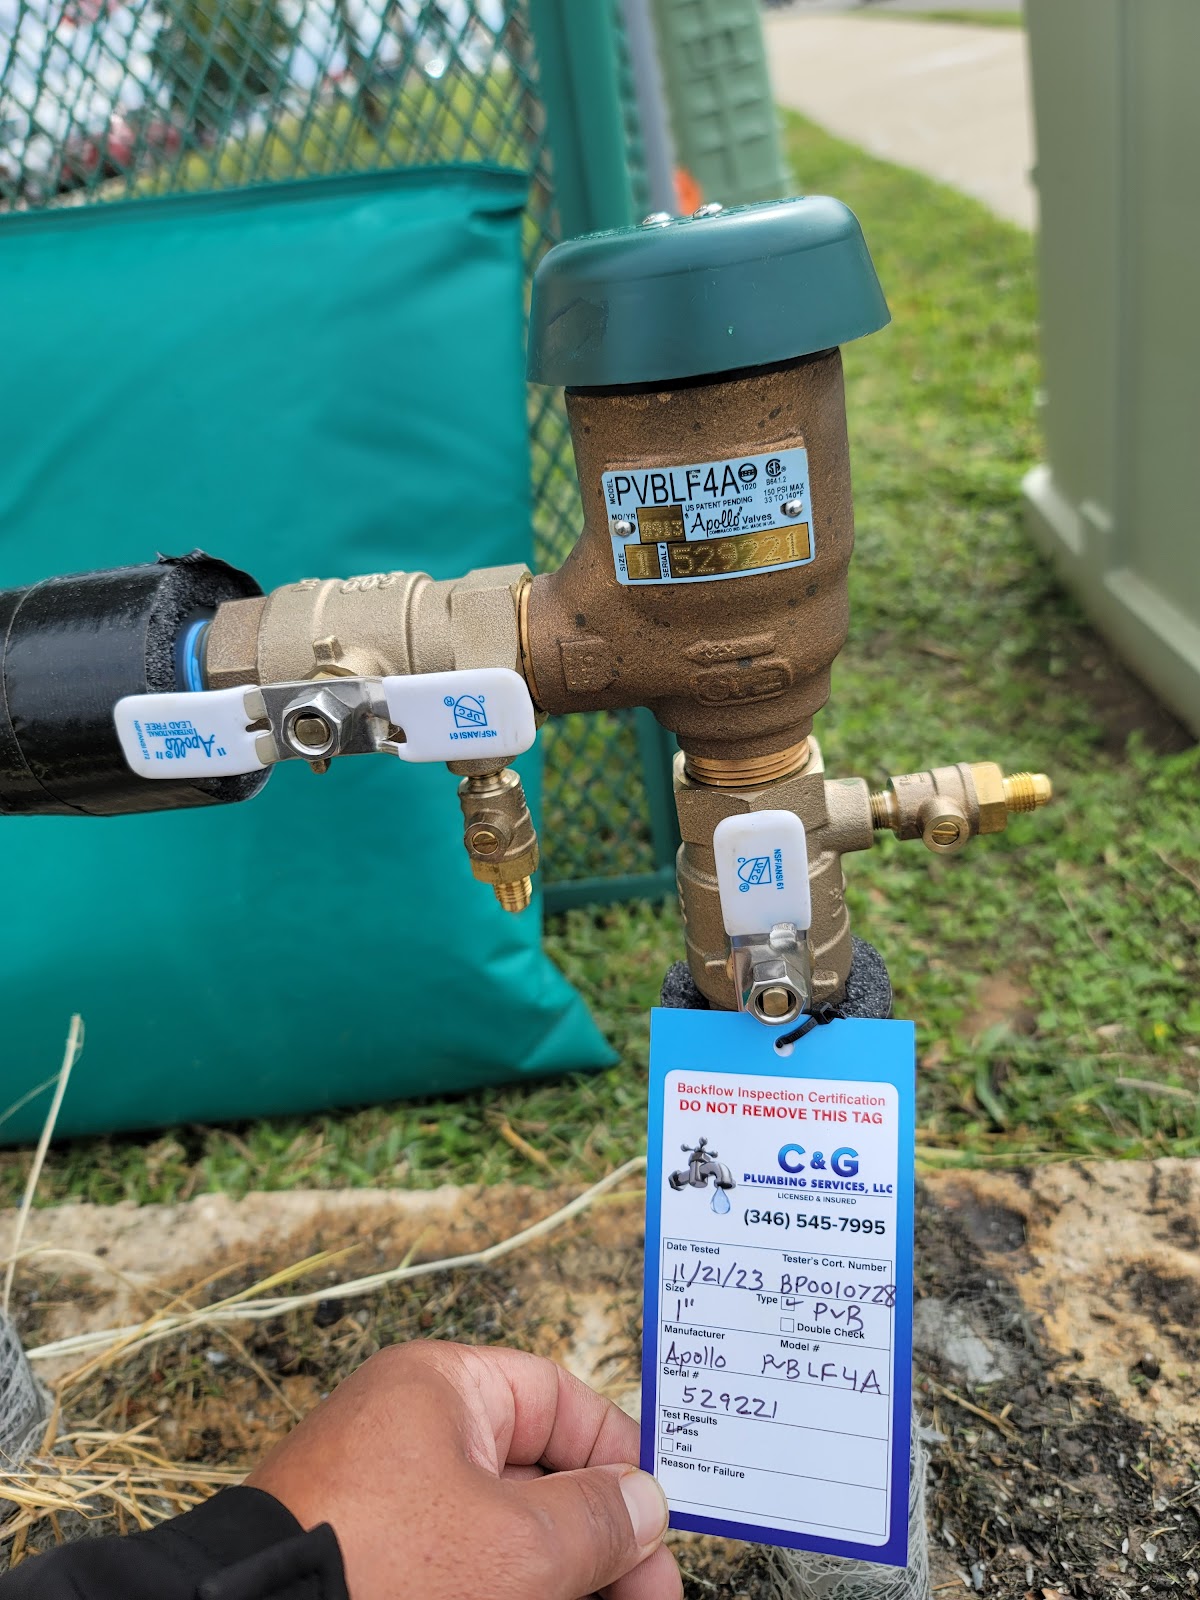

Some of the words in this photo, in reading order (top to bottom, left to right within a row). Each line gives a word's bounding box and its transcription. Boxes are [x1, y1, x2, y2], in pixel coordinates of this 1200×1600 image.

[614, 464, 741, 506] PVBLF4A
[741, 482, 757, 491] 1020
[764, 488, 775, 496] 150
[776, 486, 788, 494] PSI
[790, 483, 804, 492] MAX
[685, 504, 694, 512] US
[696, 501, 720, 510] PATENT
[722, 496, 752, 506] PENDING
[774, 494, 784, 502] TO
[742, 514, 772, 524] Valves
[672, 532, 800, 575] 529221
[618, 553, 626, 572] SIZE
[660, 551, 670, 578] SERIAL
[458, 708, 480, 720] UPC
[144, 722, 167, 730] FREE
[168, 720, 192, 729] LEAD
[146, 728, 194, 737] INTERNATIONAL
[449, 732, 458, 740] 61
[752, 862, 764, 881] UPC
[677, 1082, 734, 1097] Backflow
[738, 1086, 804, 1102] Inspection
[808, 1092, 886, 1106] Certification
[679, 1099, 701, 1112] DO
[706, 1101, 737, 1114] NOT
[742, 1104, 808, 1120] REMOVE
[812, 1108, 848, 1123] THIS
[852, 1111, 883, 1124] TAG
[743, 1173, 807, 1187] PLUMBING
[810, 1179, 869, 1193] SERVICES,
[872, 1183, 893, 1194] LLC
[777, 1193, 814, 1201] LICENSED
[823, 1196, 856, 1205] INSURED
[744, 1208, 790, 1229] (346)
[796, 1214, 886, 1235] 545-7995
[666, 1242, 687, 1252] Date
[690, 1244, 720, 1255] Tested
[782, 1254, 819, 1265] Tester's
[848, 1261, 887, 1272] Number
[672, 1260, 764, 1290] 11/21/23
[665, 1283, 685, 1293] Size
[780, 1274, 897, 1307] BP0010728
[756, 1294, 778, 1306] Type
[664, 1325, 725, 1340] Manufacturer
[797, 1323, 831, 1335] Double
[834, 1327, 865, 1339] Check
[780, 1340, 810, 1351] Model
[665, 1341, 726, 1371] Apollo
[663, 1367, 690, 1378] Serial
[682, 1386, 778, 1419] 529221
[662, 1410, 681, 1420] Test
[683, 1412, 718, 1425] Results
[676, 1426, 699, 1436] Pass
[676, 1442, 692, 1452] Fail
[661, 1457, 695, 1470] Reason
[698, 1463, 711, 1473] for
[713, 1466, 745, 1479] Failure
